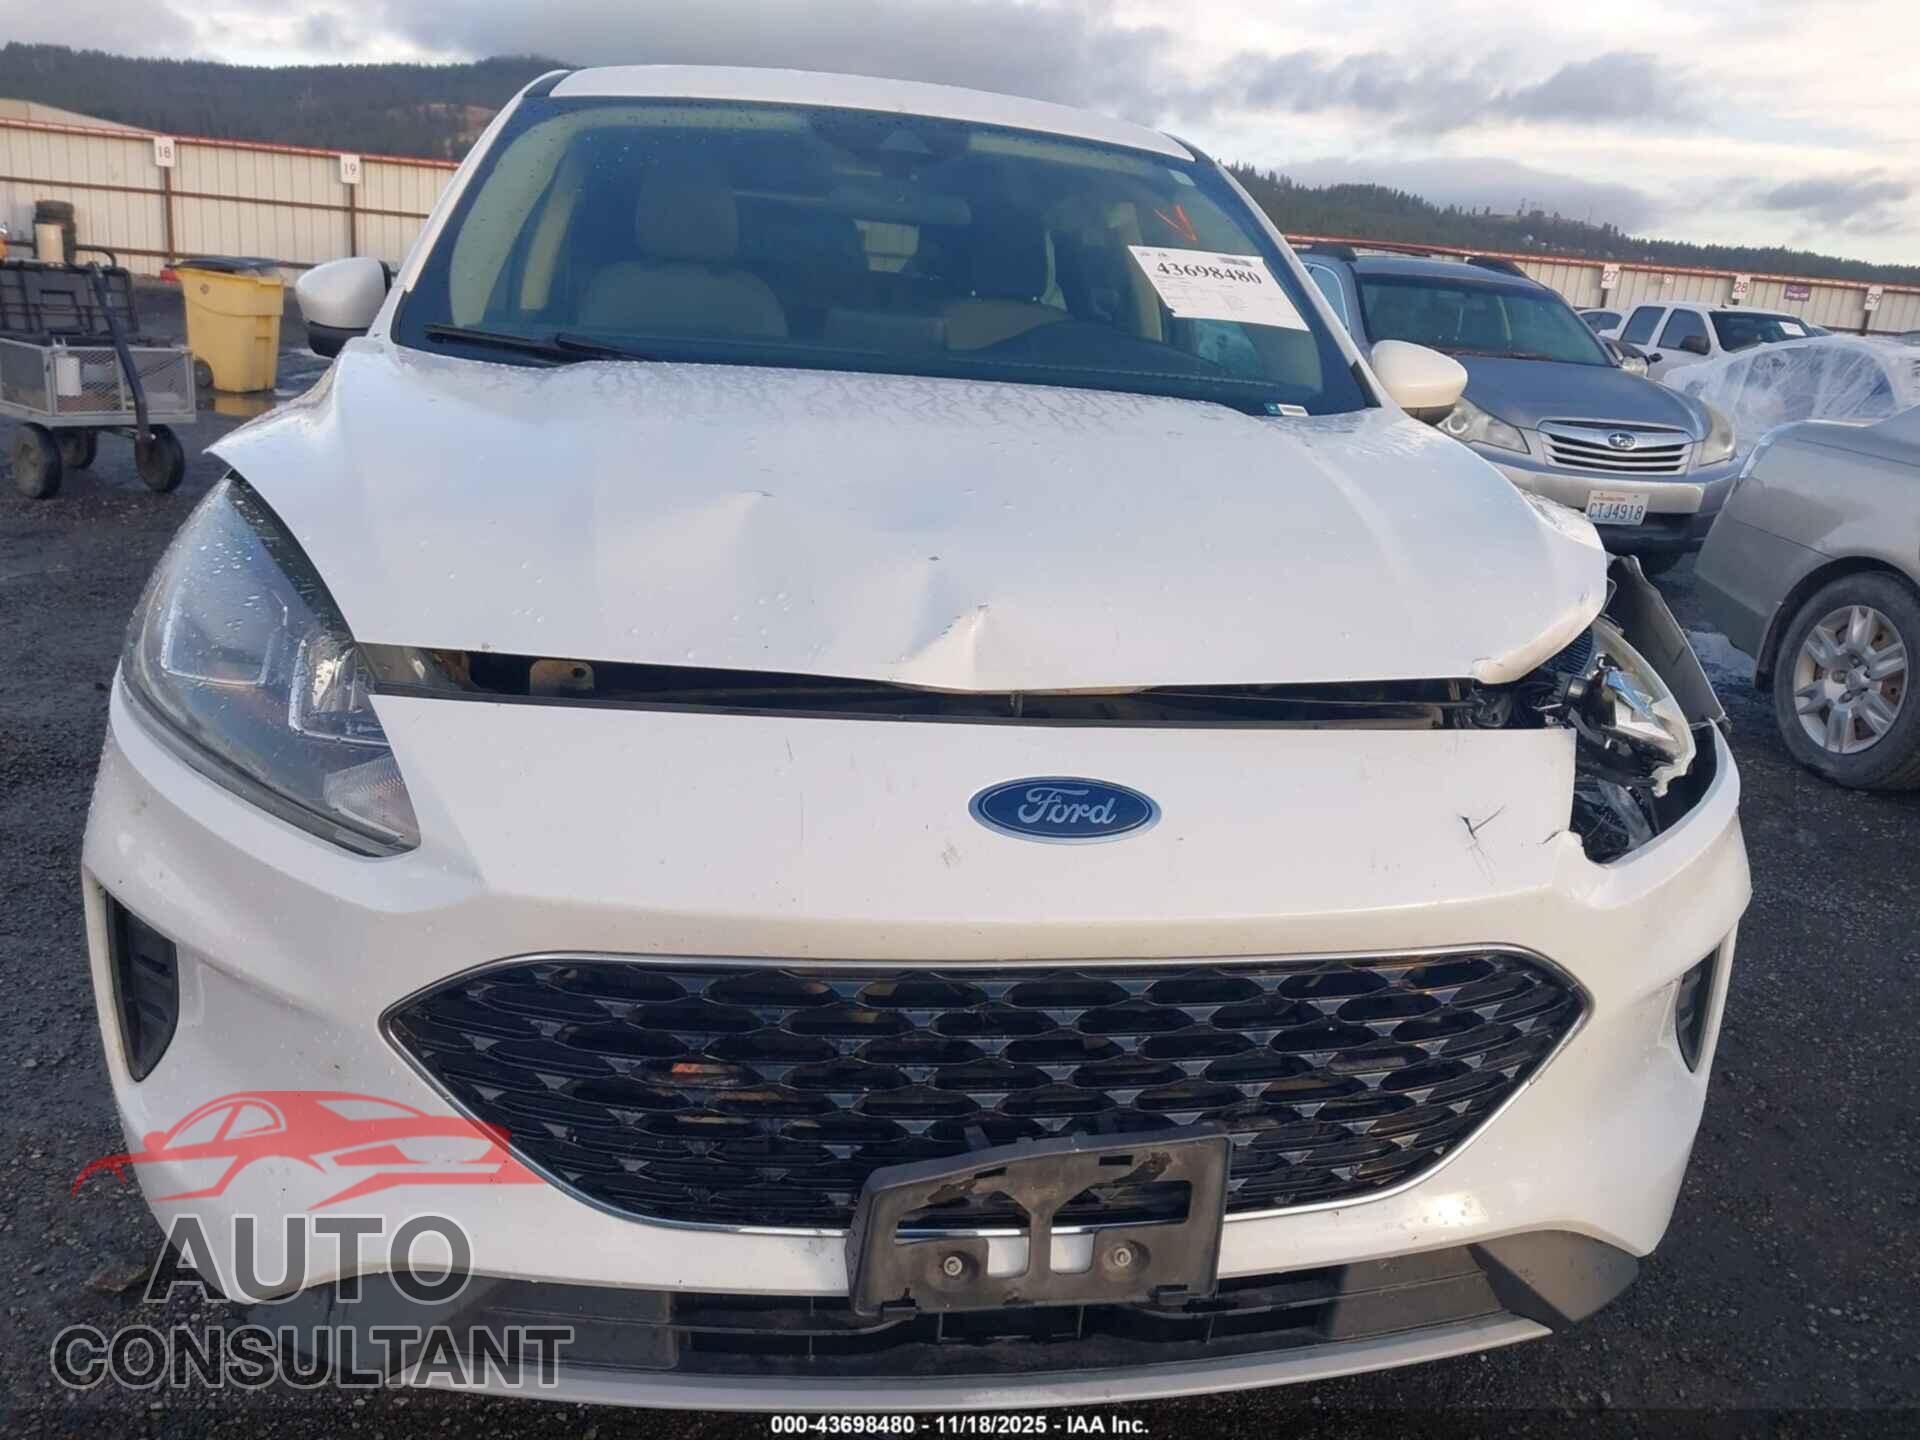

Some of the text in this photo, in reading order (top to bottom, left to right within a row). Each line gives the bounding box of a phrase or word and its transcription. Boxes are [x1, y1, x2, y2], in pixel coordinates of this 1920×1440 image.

[158, 145, 172, 159] 18
[344, 162, 357, 176] 19
[1156, 261, 1263, 285] 43698480
[1601, 270, 1617, 282] 27
[1017, 787, 1117, 824] Ford
